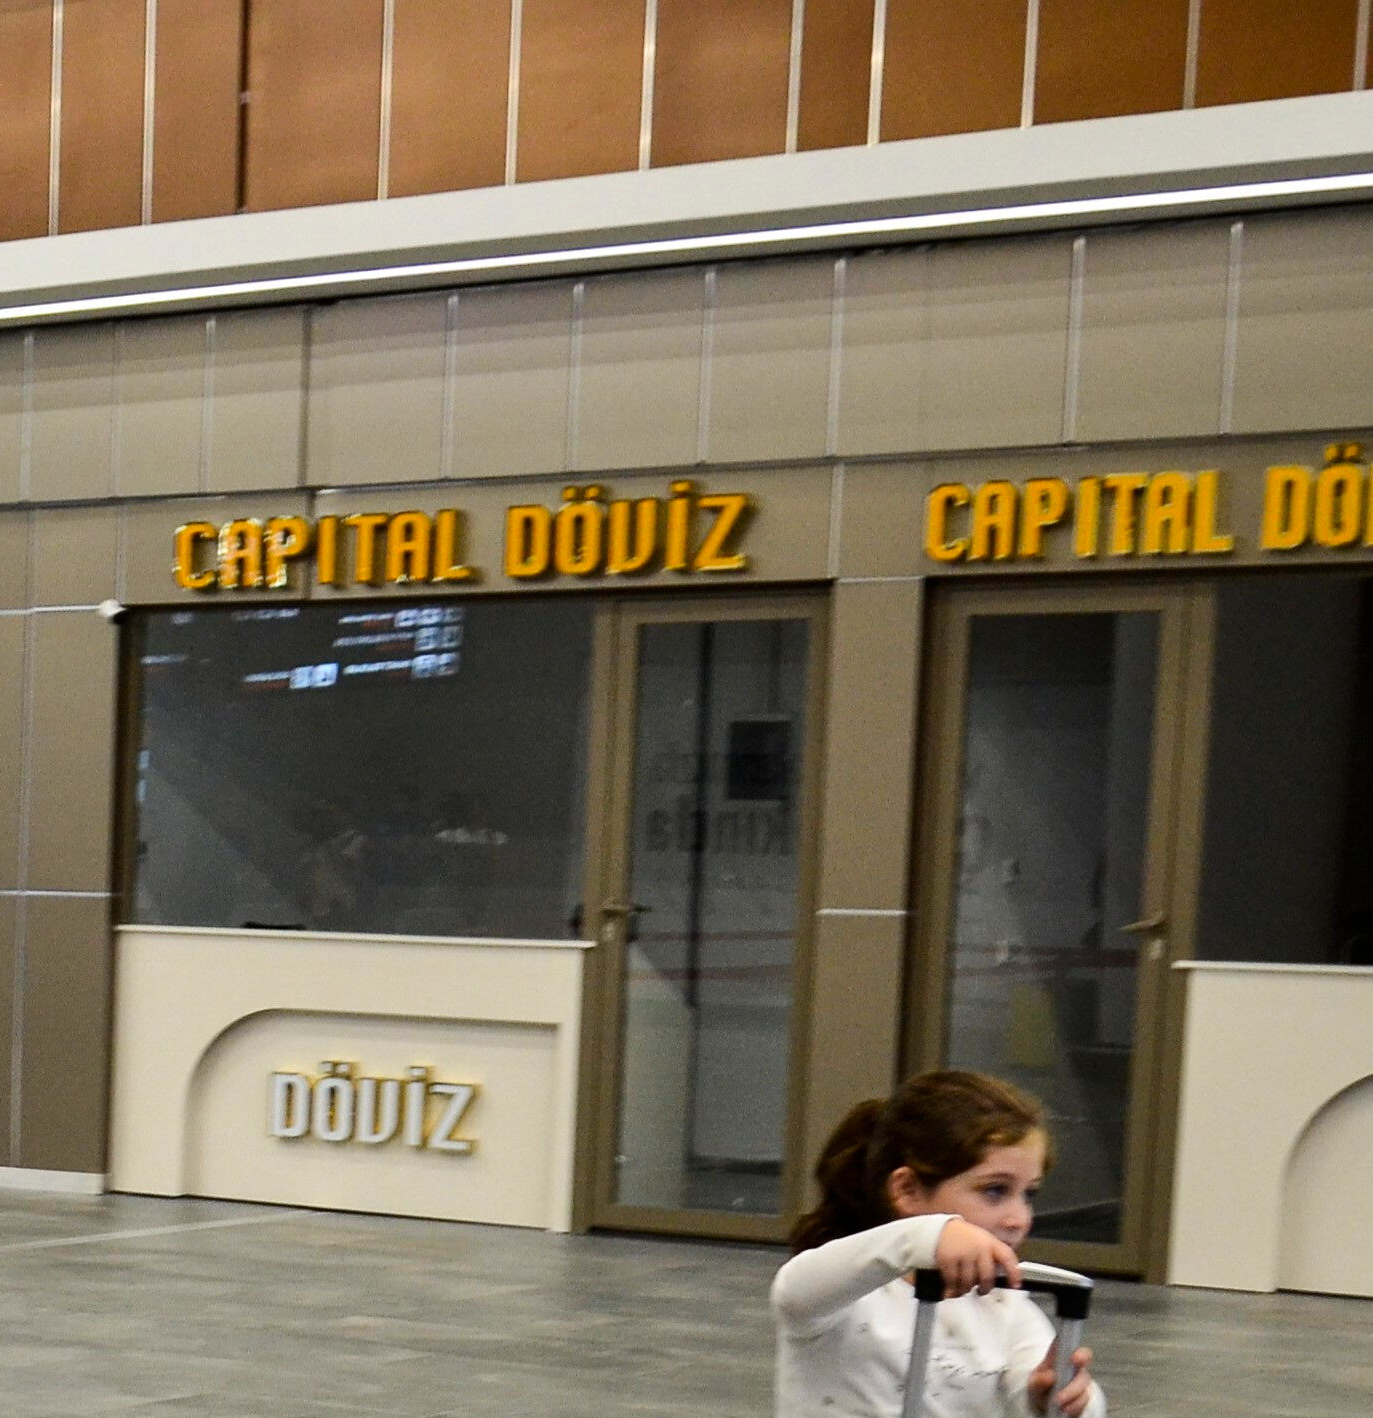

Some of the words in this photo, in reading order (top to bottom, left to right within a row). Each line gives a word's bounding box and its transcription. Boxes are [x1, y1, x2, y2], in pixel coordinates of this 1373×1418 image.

[173, 508, 473, 589] CAPITAL
[504, 480, 751, 577] DÖVİZ
[926, 470, 1235, 561] CAPITAL
[1260, 443, 1373, 550] DÖ
[271, 1060, 476, 1153] DÖVİZ
